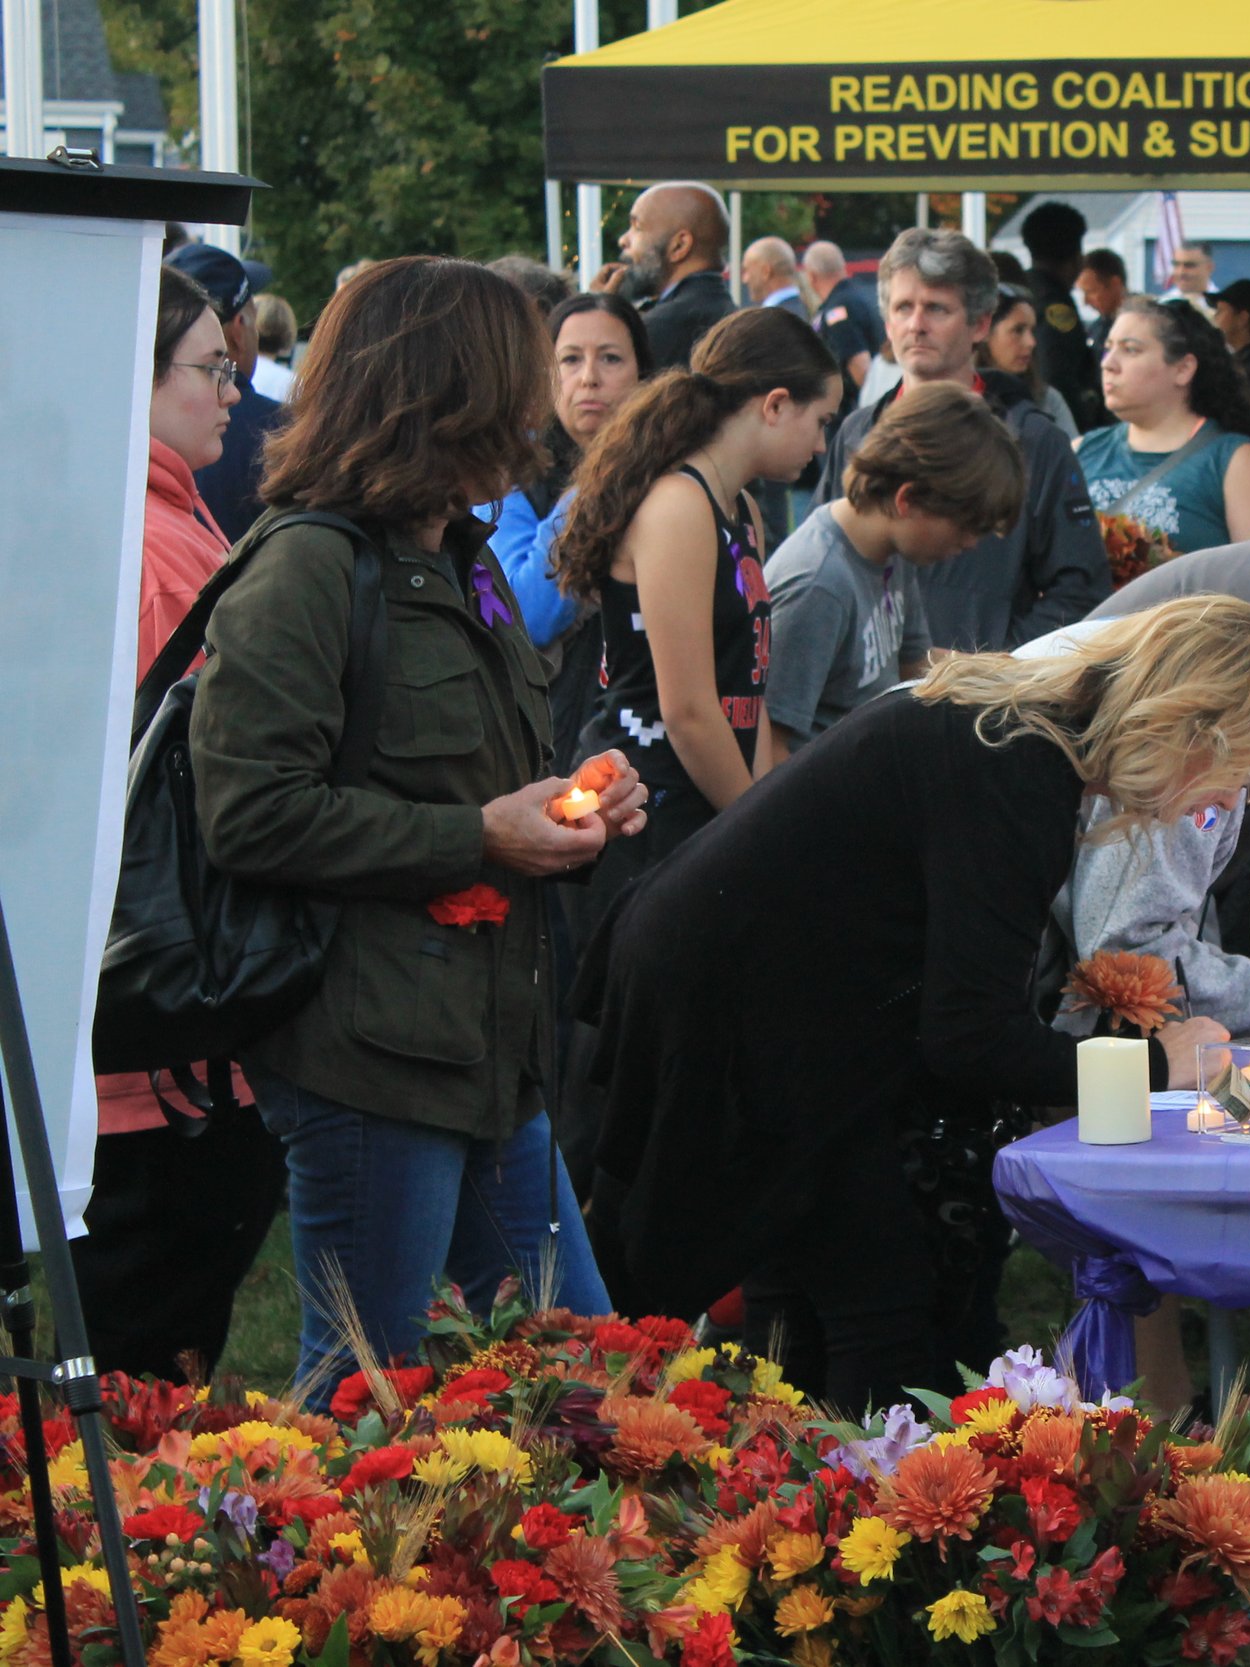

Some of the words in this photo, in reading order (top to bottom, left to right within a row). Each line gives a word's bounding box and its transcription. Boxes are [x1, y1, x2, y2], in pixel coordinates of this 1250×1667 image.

[830, 72, 1039, 113] READING
[726, 125, 822, 163] FOR
[834, 120, 1129, 162] PREVENTION
[1143, 119, 1176, 158] &
